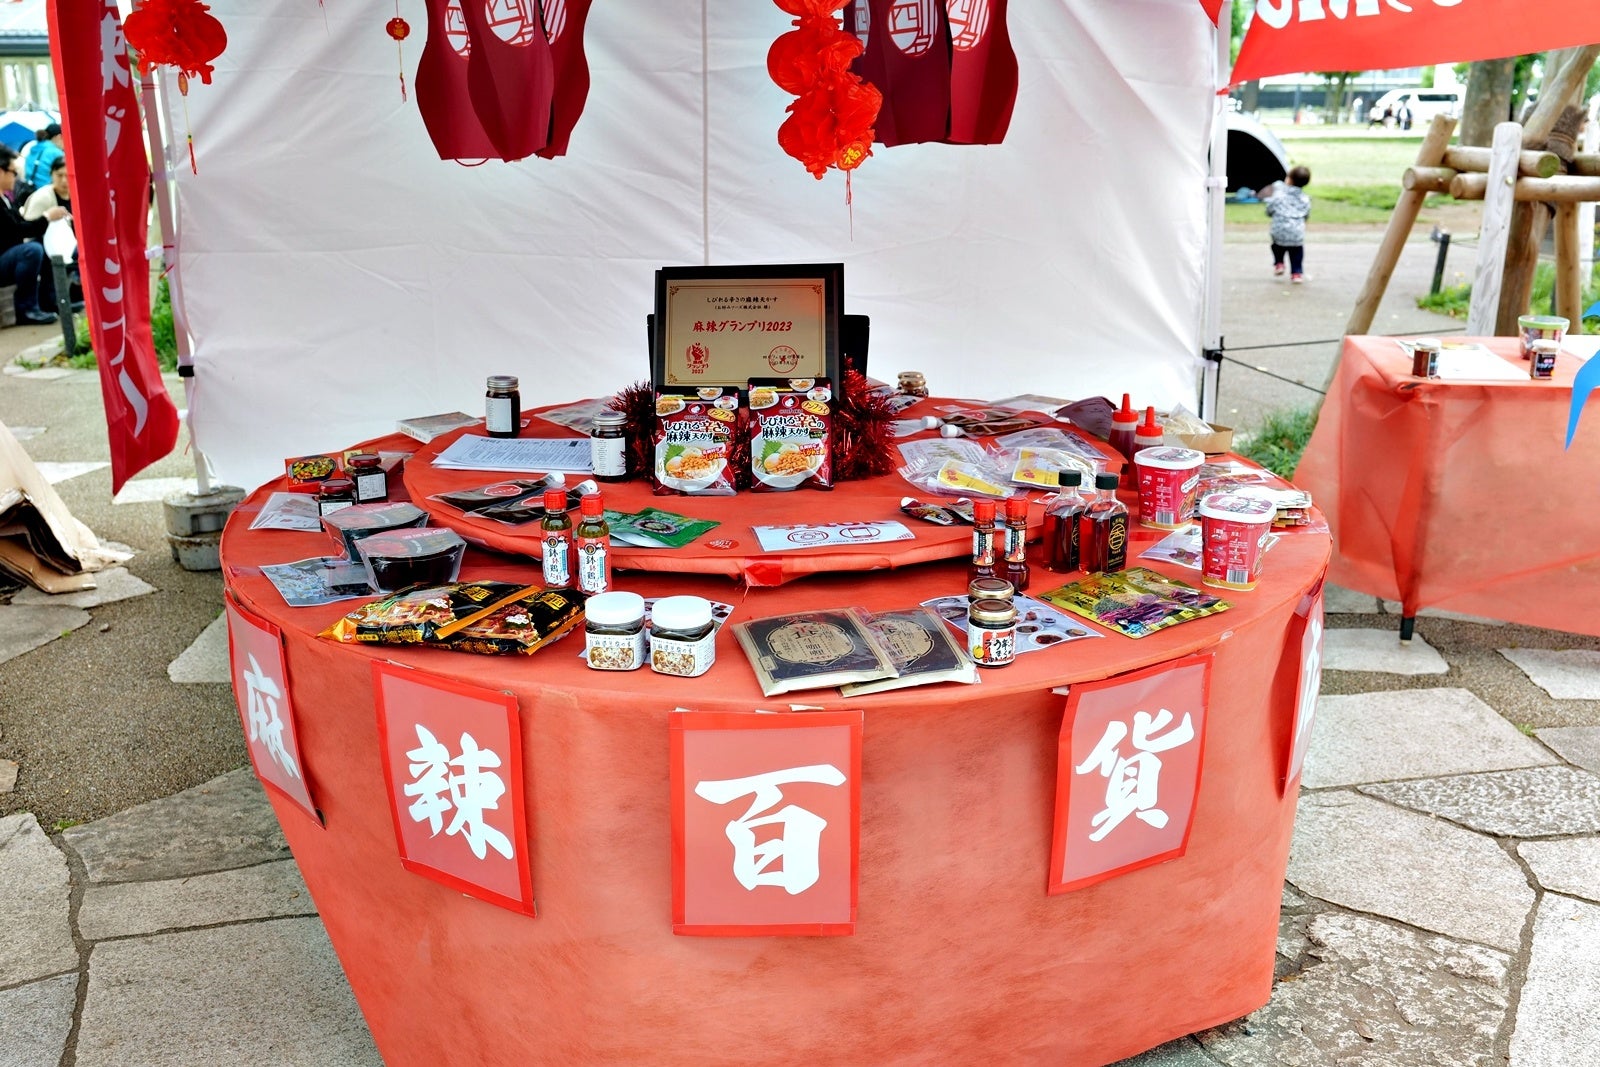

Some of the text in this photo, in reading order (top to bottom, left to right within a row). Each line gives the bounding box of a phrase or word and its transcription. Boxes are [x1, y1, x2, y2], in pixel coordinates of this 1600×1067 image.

[692, 320, 793, 333] 麻辣グランプリ2023
[664, 420, 730, 434] しびれる辛さの
[760, 415, 825, 429] しびれる辛さの
[666, 431, 713, 442] 麻辣天かす
[762, 427, 809, 440] 麻辣天かす
[244, 652, 300, 779] 麻
[404, 723, 514, 860] 辣
[695, 764, 847, 896] 百
[1075, 708, 1195, 842] 貨
